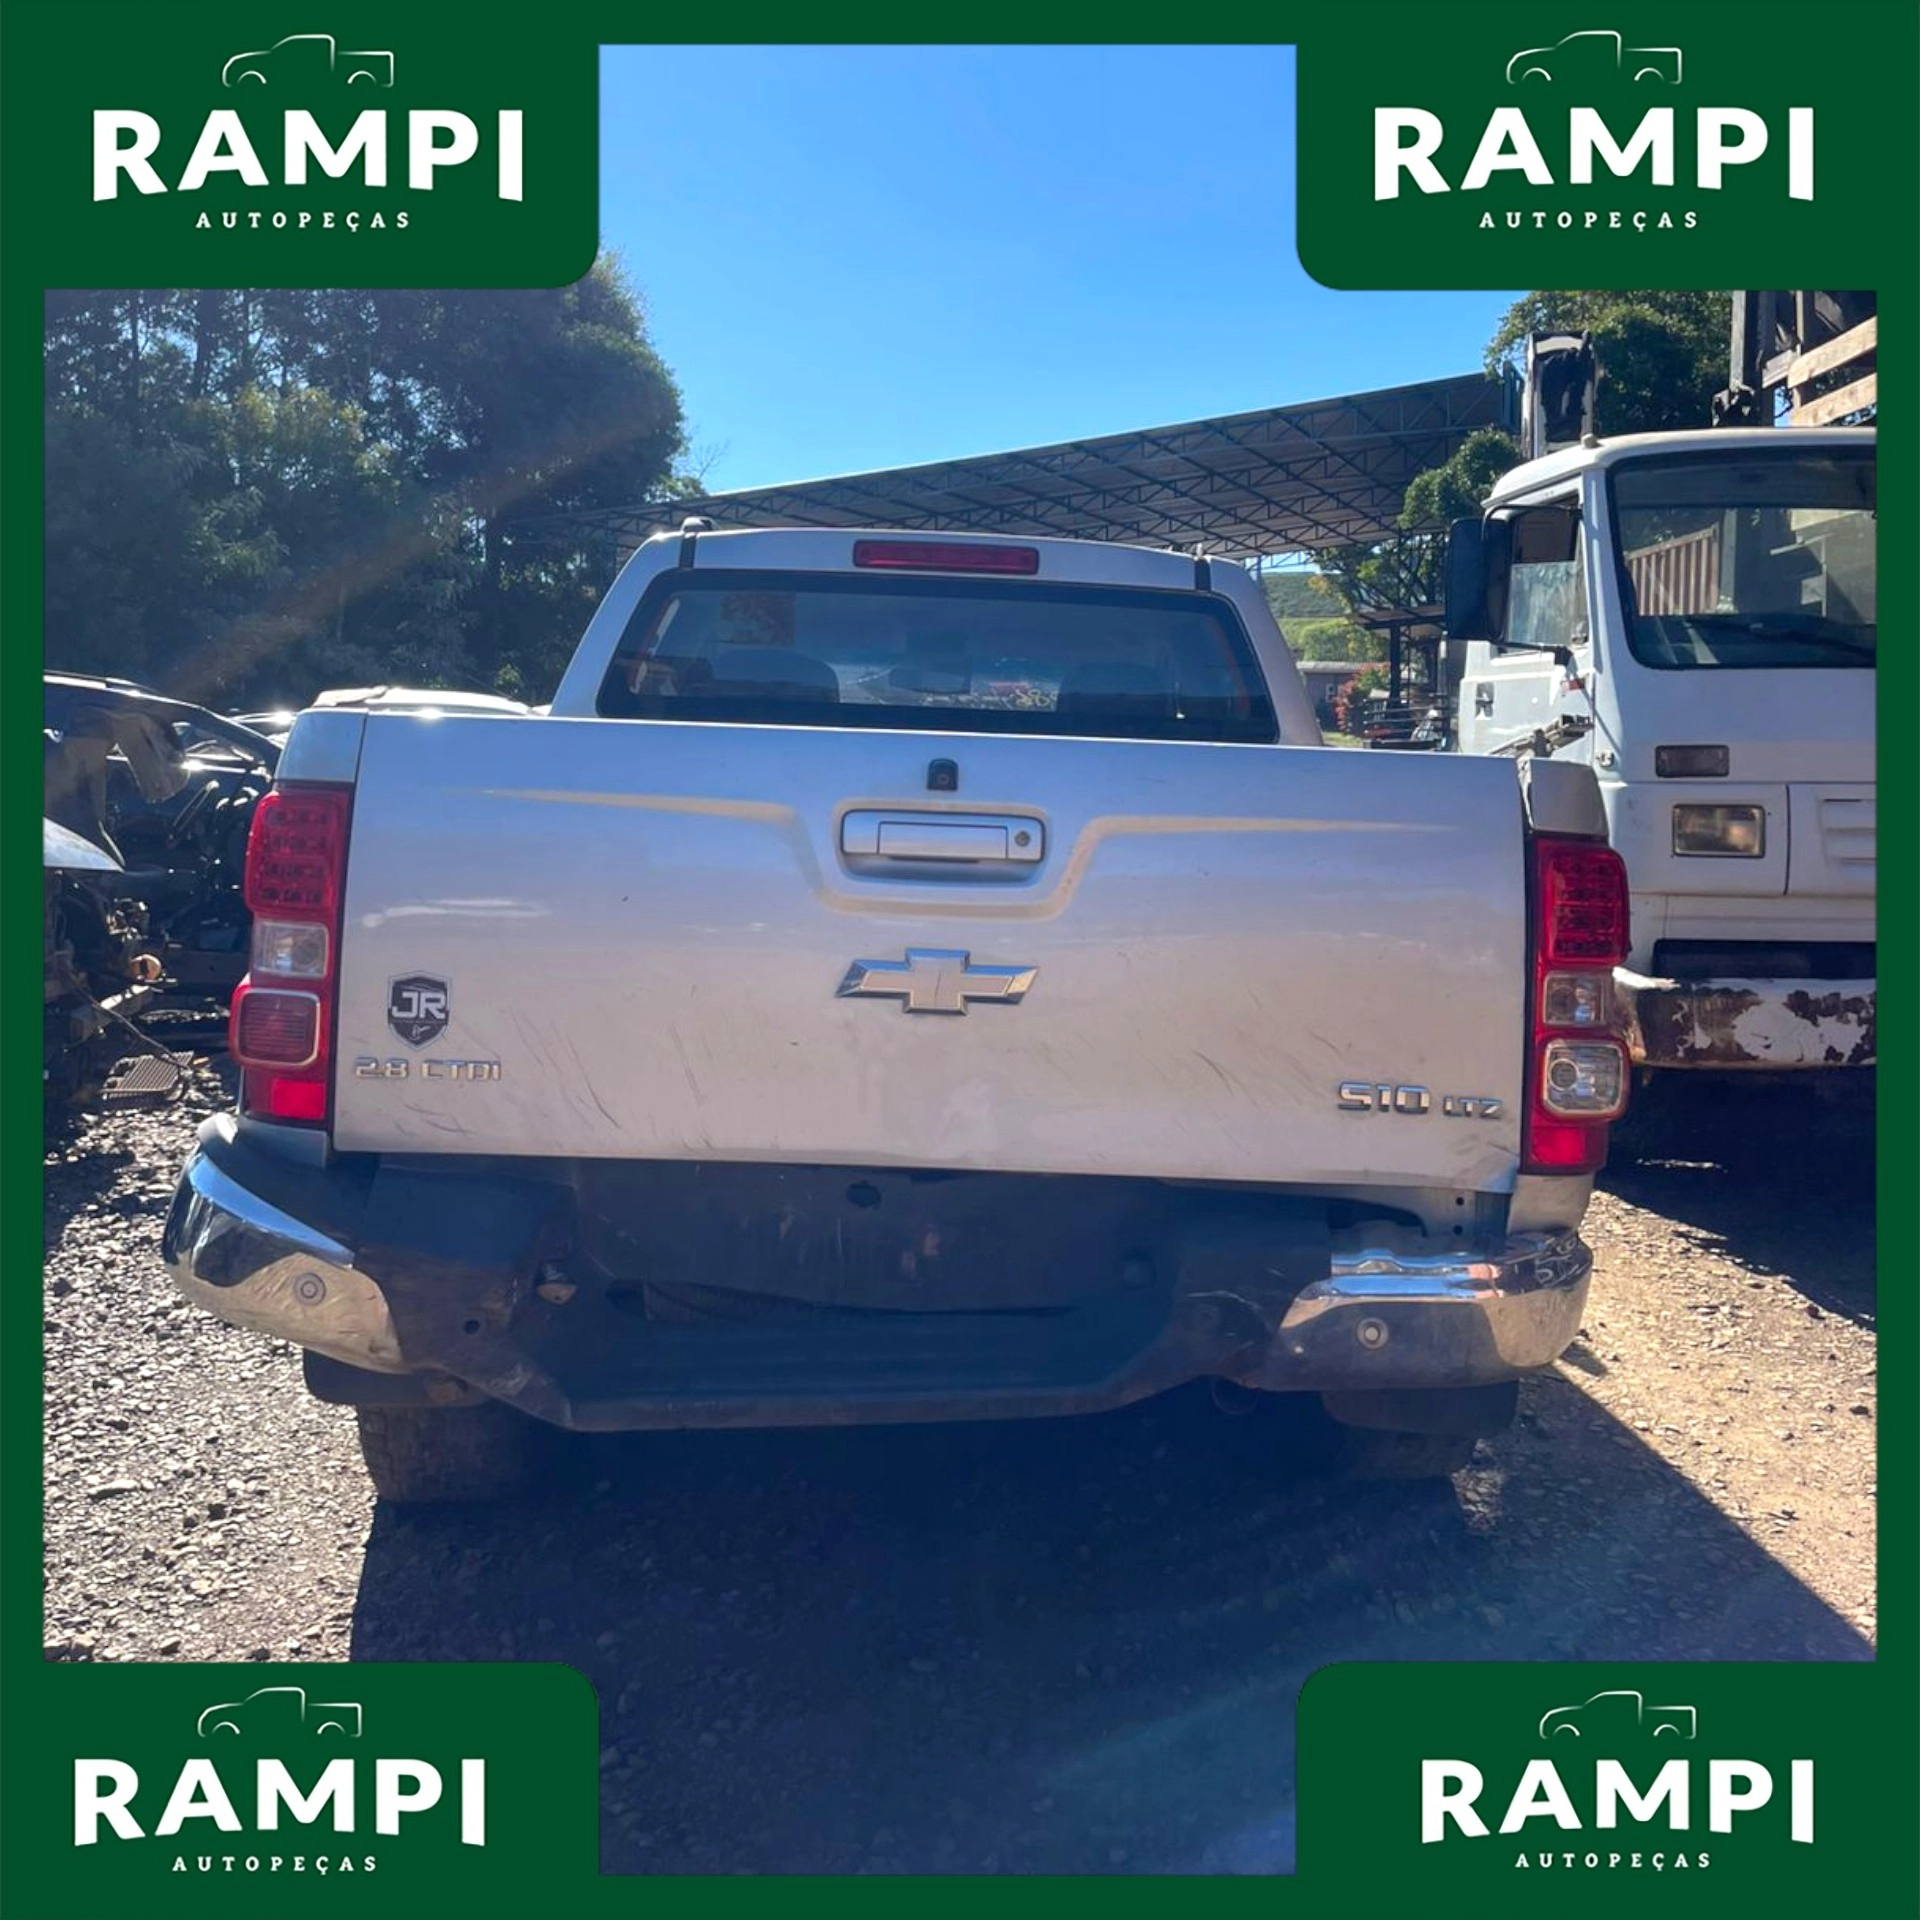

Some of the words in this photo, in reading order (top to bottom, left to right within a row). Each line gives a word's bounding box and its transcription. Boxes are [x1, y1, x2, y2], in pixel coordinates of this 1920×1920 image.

[391, 991, 446, 1019] JR
[421, 1059, 501, 1081] CTDI
[1338, 1081, 1429, 1114] S10
[1443, 1097, 1502, 1119] LTZ
